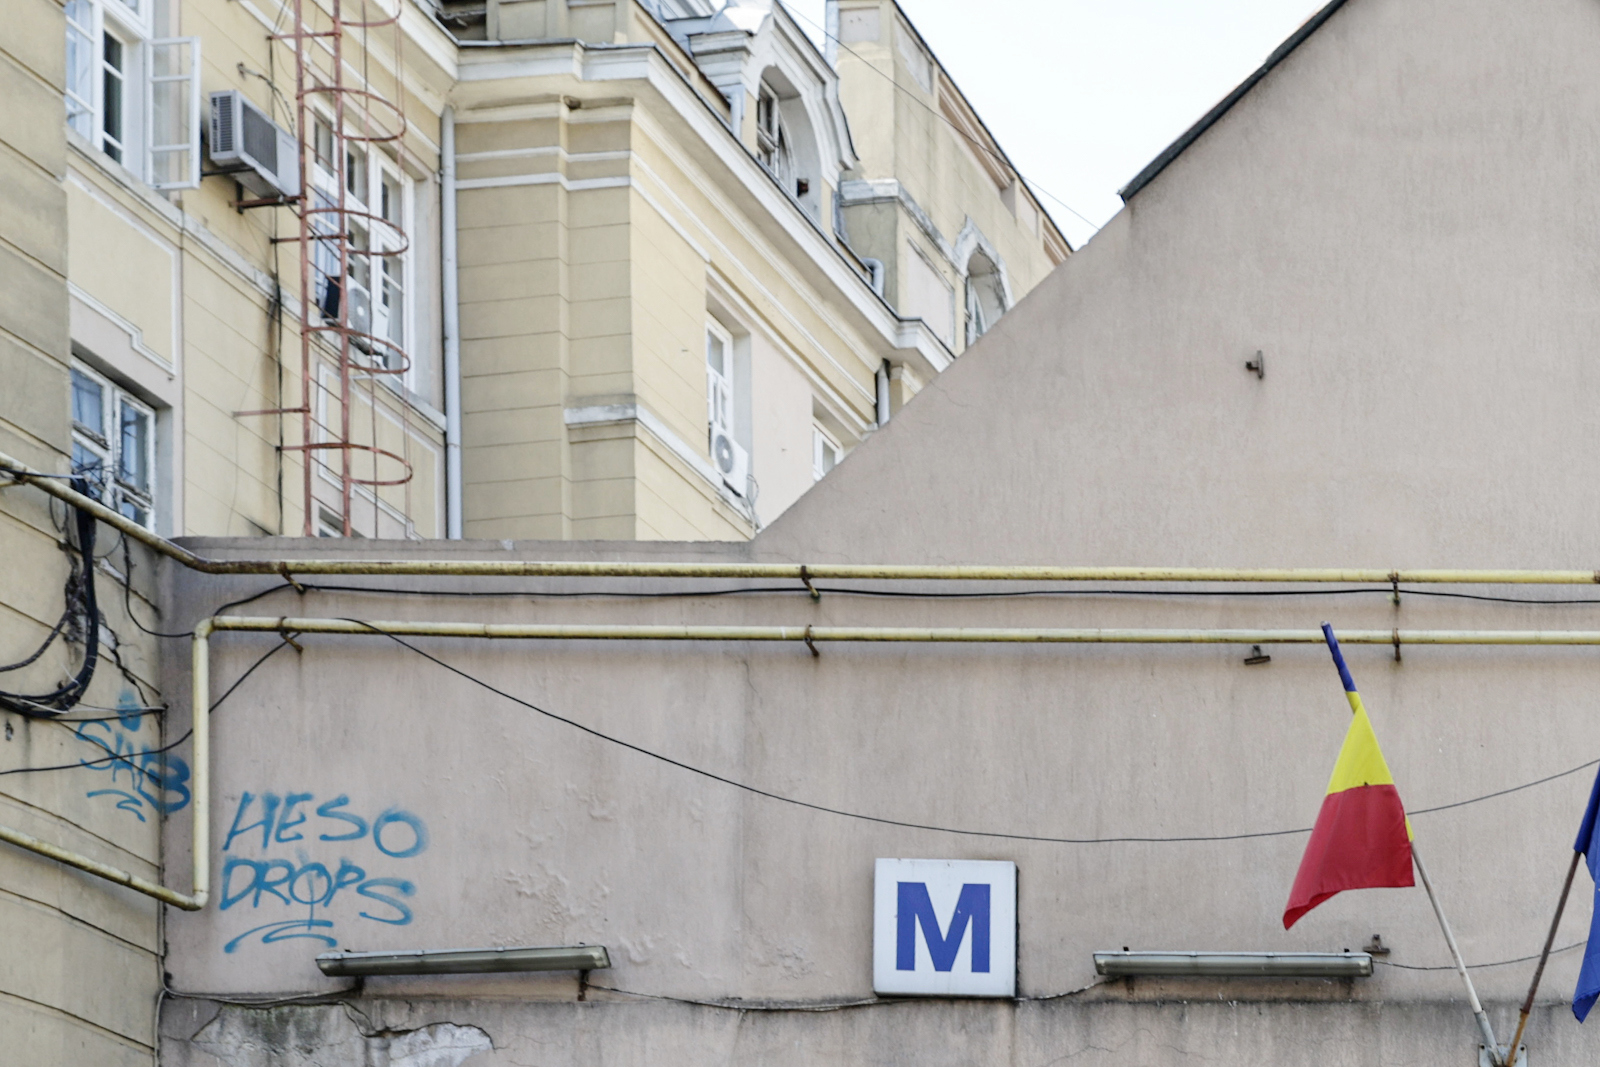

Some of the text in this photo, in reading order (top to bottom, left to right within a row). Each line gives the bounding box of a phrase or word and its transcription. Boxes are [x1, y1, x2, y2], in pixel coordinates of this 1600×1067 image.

[222, 792, 429, 858] HESO
[219, 854, 416, 926] DROPS
[896, 881, 991, 973] M
